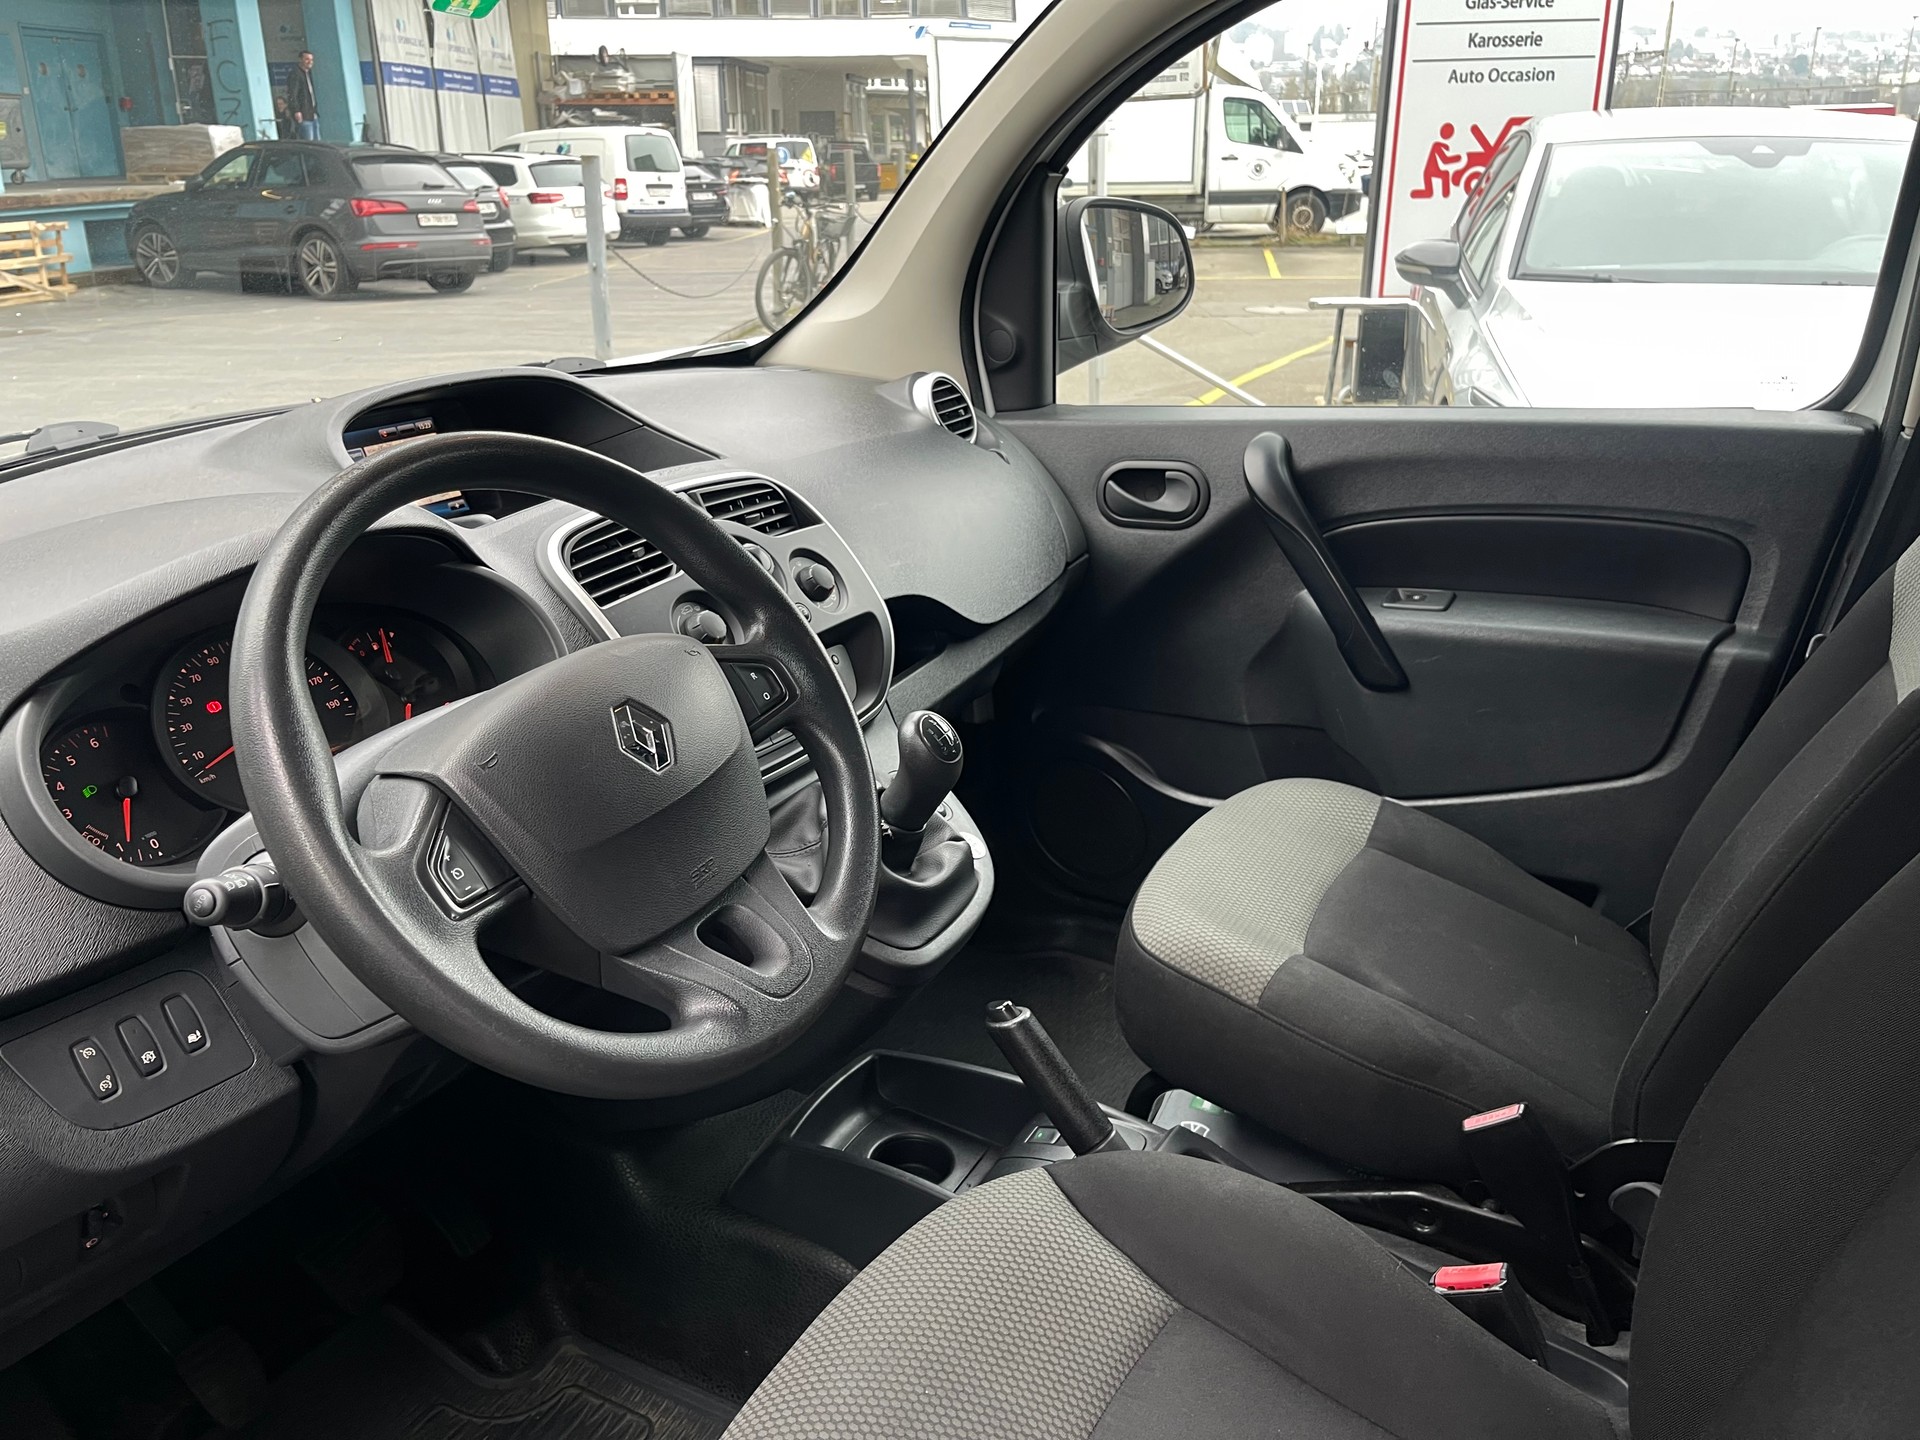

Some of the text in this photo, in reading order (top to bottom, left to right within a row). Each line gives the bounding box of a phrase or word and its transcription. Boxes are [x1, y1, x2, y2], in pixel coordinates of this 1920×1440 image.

[1468, 31, 1543, 48] Karosserie
[1448, 67, 1556, 84] Auto Occasion
[206, 656, 220, 667] 90
[189, 673, 202, 684] 70
[308, 676, 323, 687] 170
[179, 696, 193, 707] 50
[325, 699, 341, 710] 190
[179, 722, 193, 733] 30
[89, 737, 100, 748] 6
[65, 755, 77, 766] 5
[192, 750, 205, 761] 10
[199, 773, 217, 784] km/h
[56, 781, 65, 792] 4
[62, 808, 73, 819] 3
[81, 831, 101, 846] ECO
[149, 838, 160, 849] 0
[115, 842, 124, 852] 1
